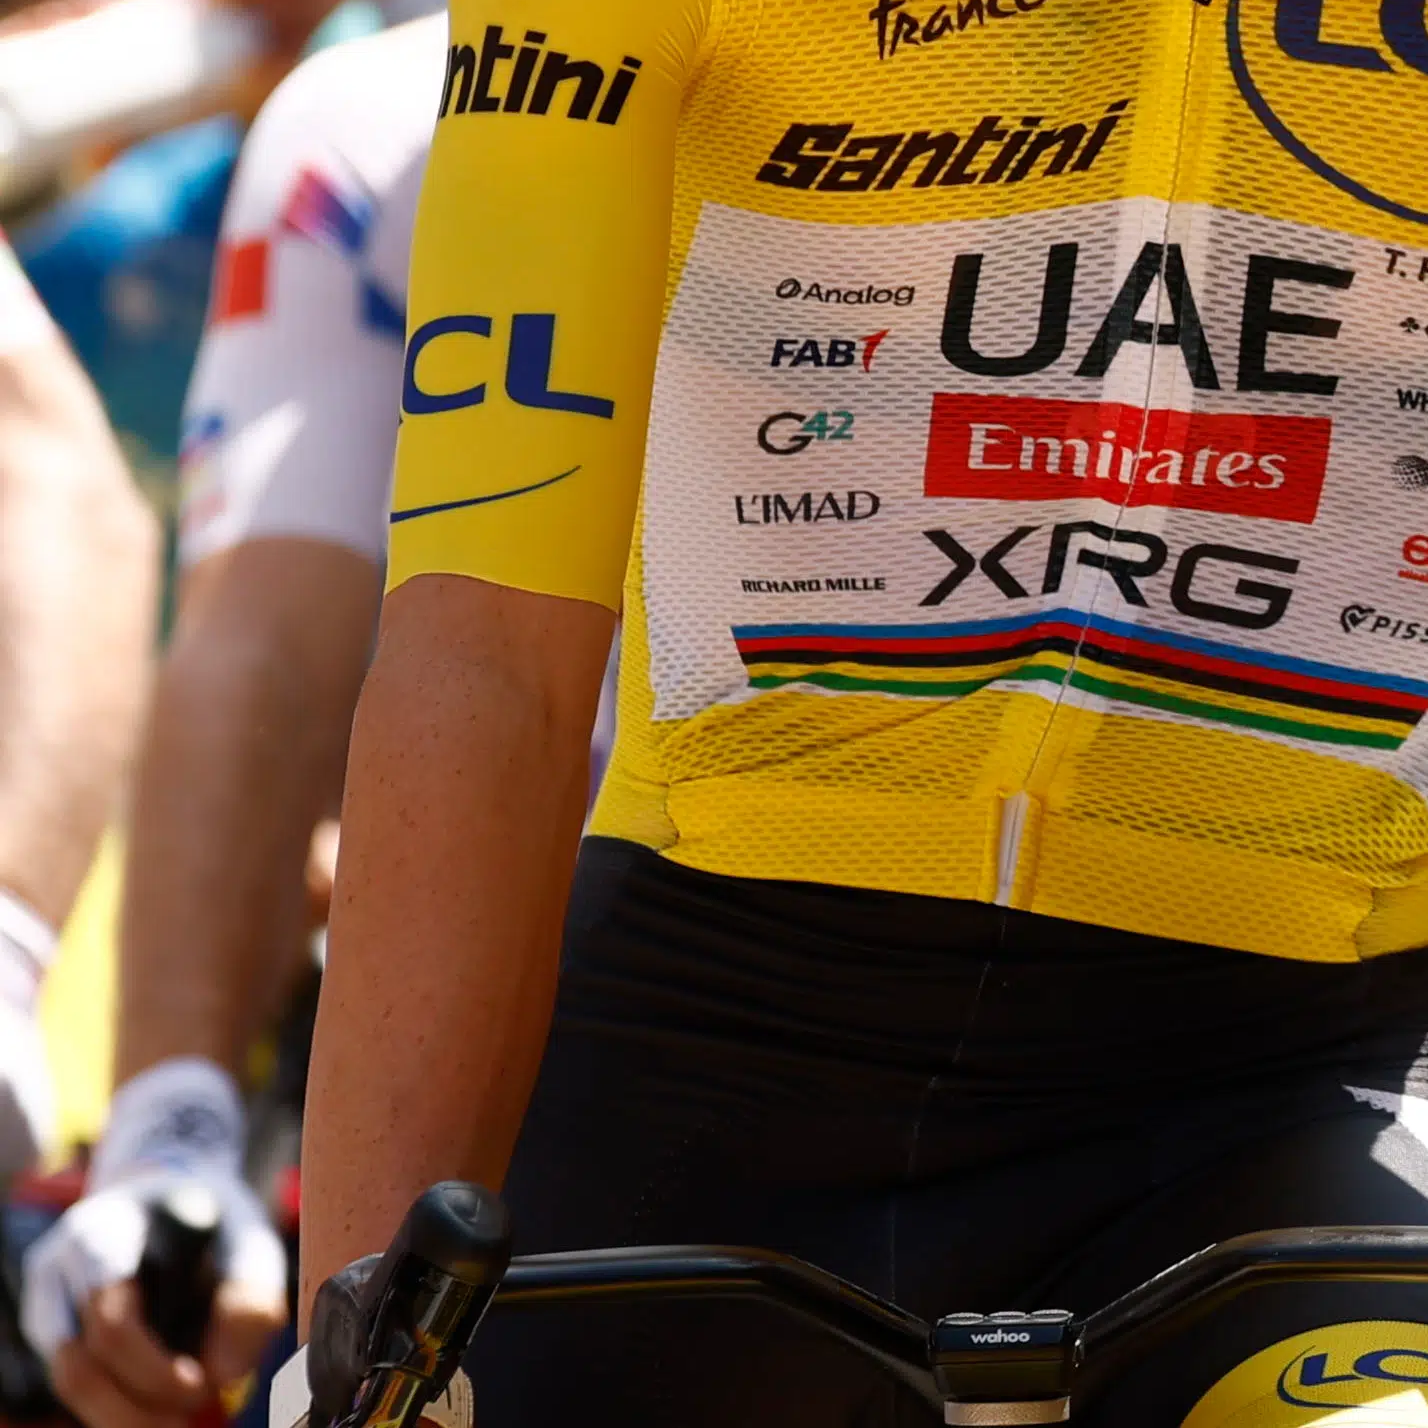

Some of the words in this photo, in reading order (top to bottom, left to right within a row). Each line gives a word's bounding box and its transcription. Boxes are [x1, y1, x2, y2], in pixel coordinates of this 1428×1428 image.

[755, 98, 1130, 192] Santini
[1384, 247, 1407, 279] T.
[802, 282, 916, 307] Analog
[939, 240, 1358, 396] UAE
[757, 409, 856, 456] G42
[967, 422, 1288, 492] Emirates
[740, 577, 823, 594] RICHARD
[825, 576, 887, 592] MILLE
[917, 520, 1300, 630] XRG
[970, 1328, 1031, 1344] wahoo
